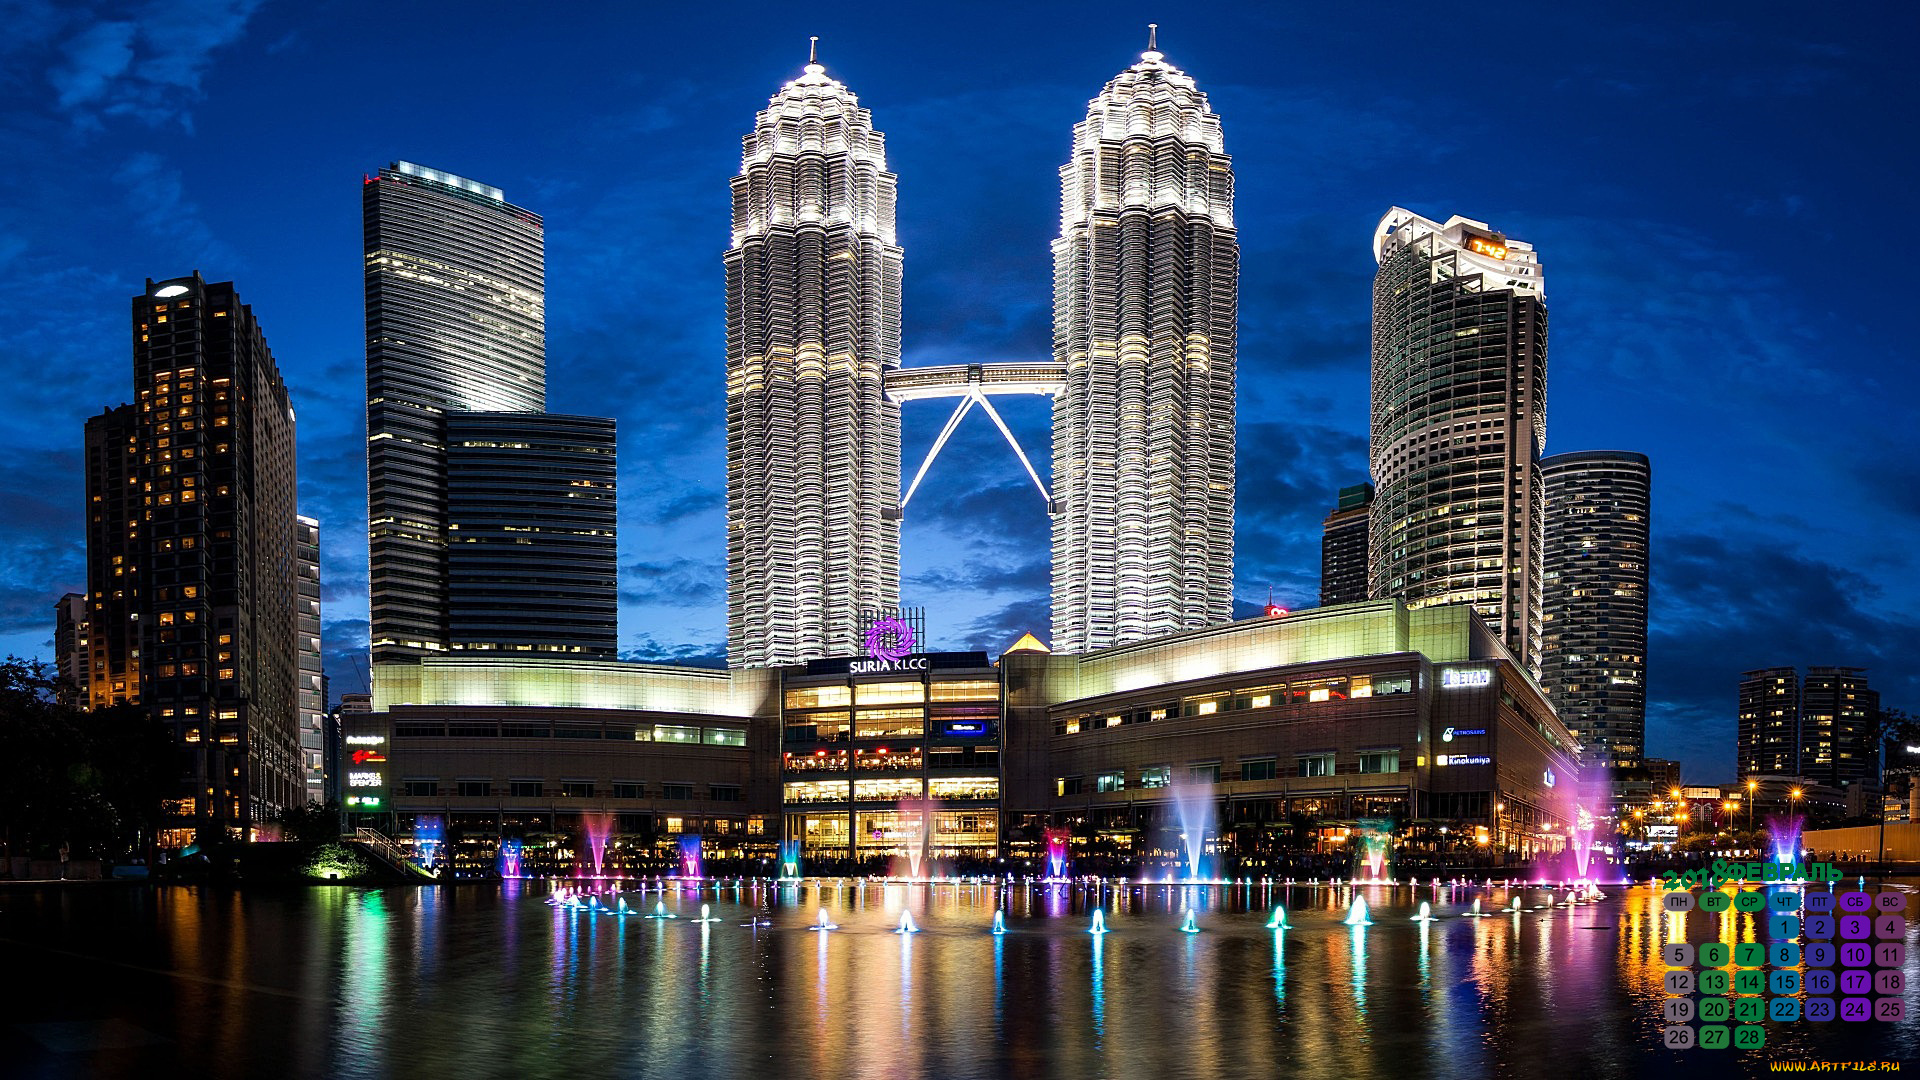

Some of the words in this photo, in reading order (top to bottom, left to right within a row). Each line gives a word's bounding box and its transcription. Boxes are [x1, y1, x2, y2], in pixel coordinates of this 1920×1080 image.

[1474, 240, 1506, 259] 7:42
[849, 660, 891, 674] SURIA
[894, 658, 928, 671] KLCC
[1449, 756, 1491, 766] Kinokuniya
